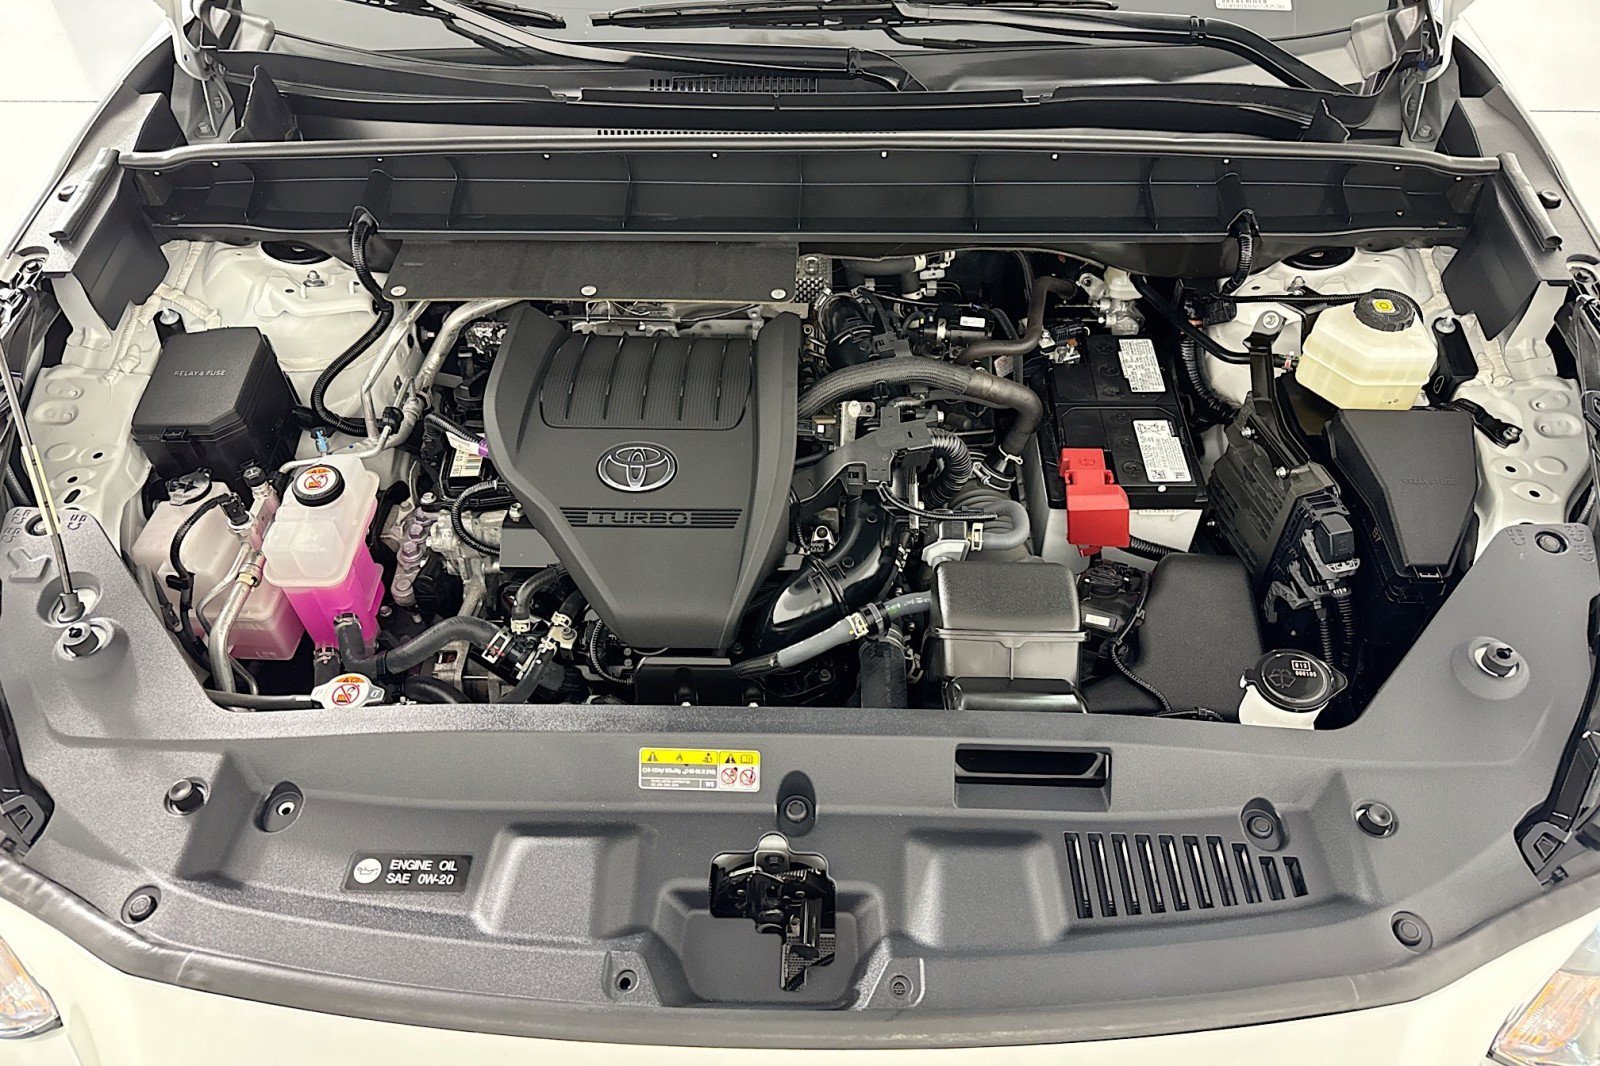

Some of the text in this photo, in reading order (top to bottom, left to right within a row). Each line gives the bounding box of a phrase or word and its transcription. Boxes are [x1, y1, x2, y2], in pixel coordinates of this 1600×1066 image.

[591, 512, 688, 524] TURBO
[389, 859, 458, 872] ENGINE OIL
[385, 872, 455, 885] SAE 0W-20
